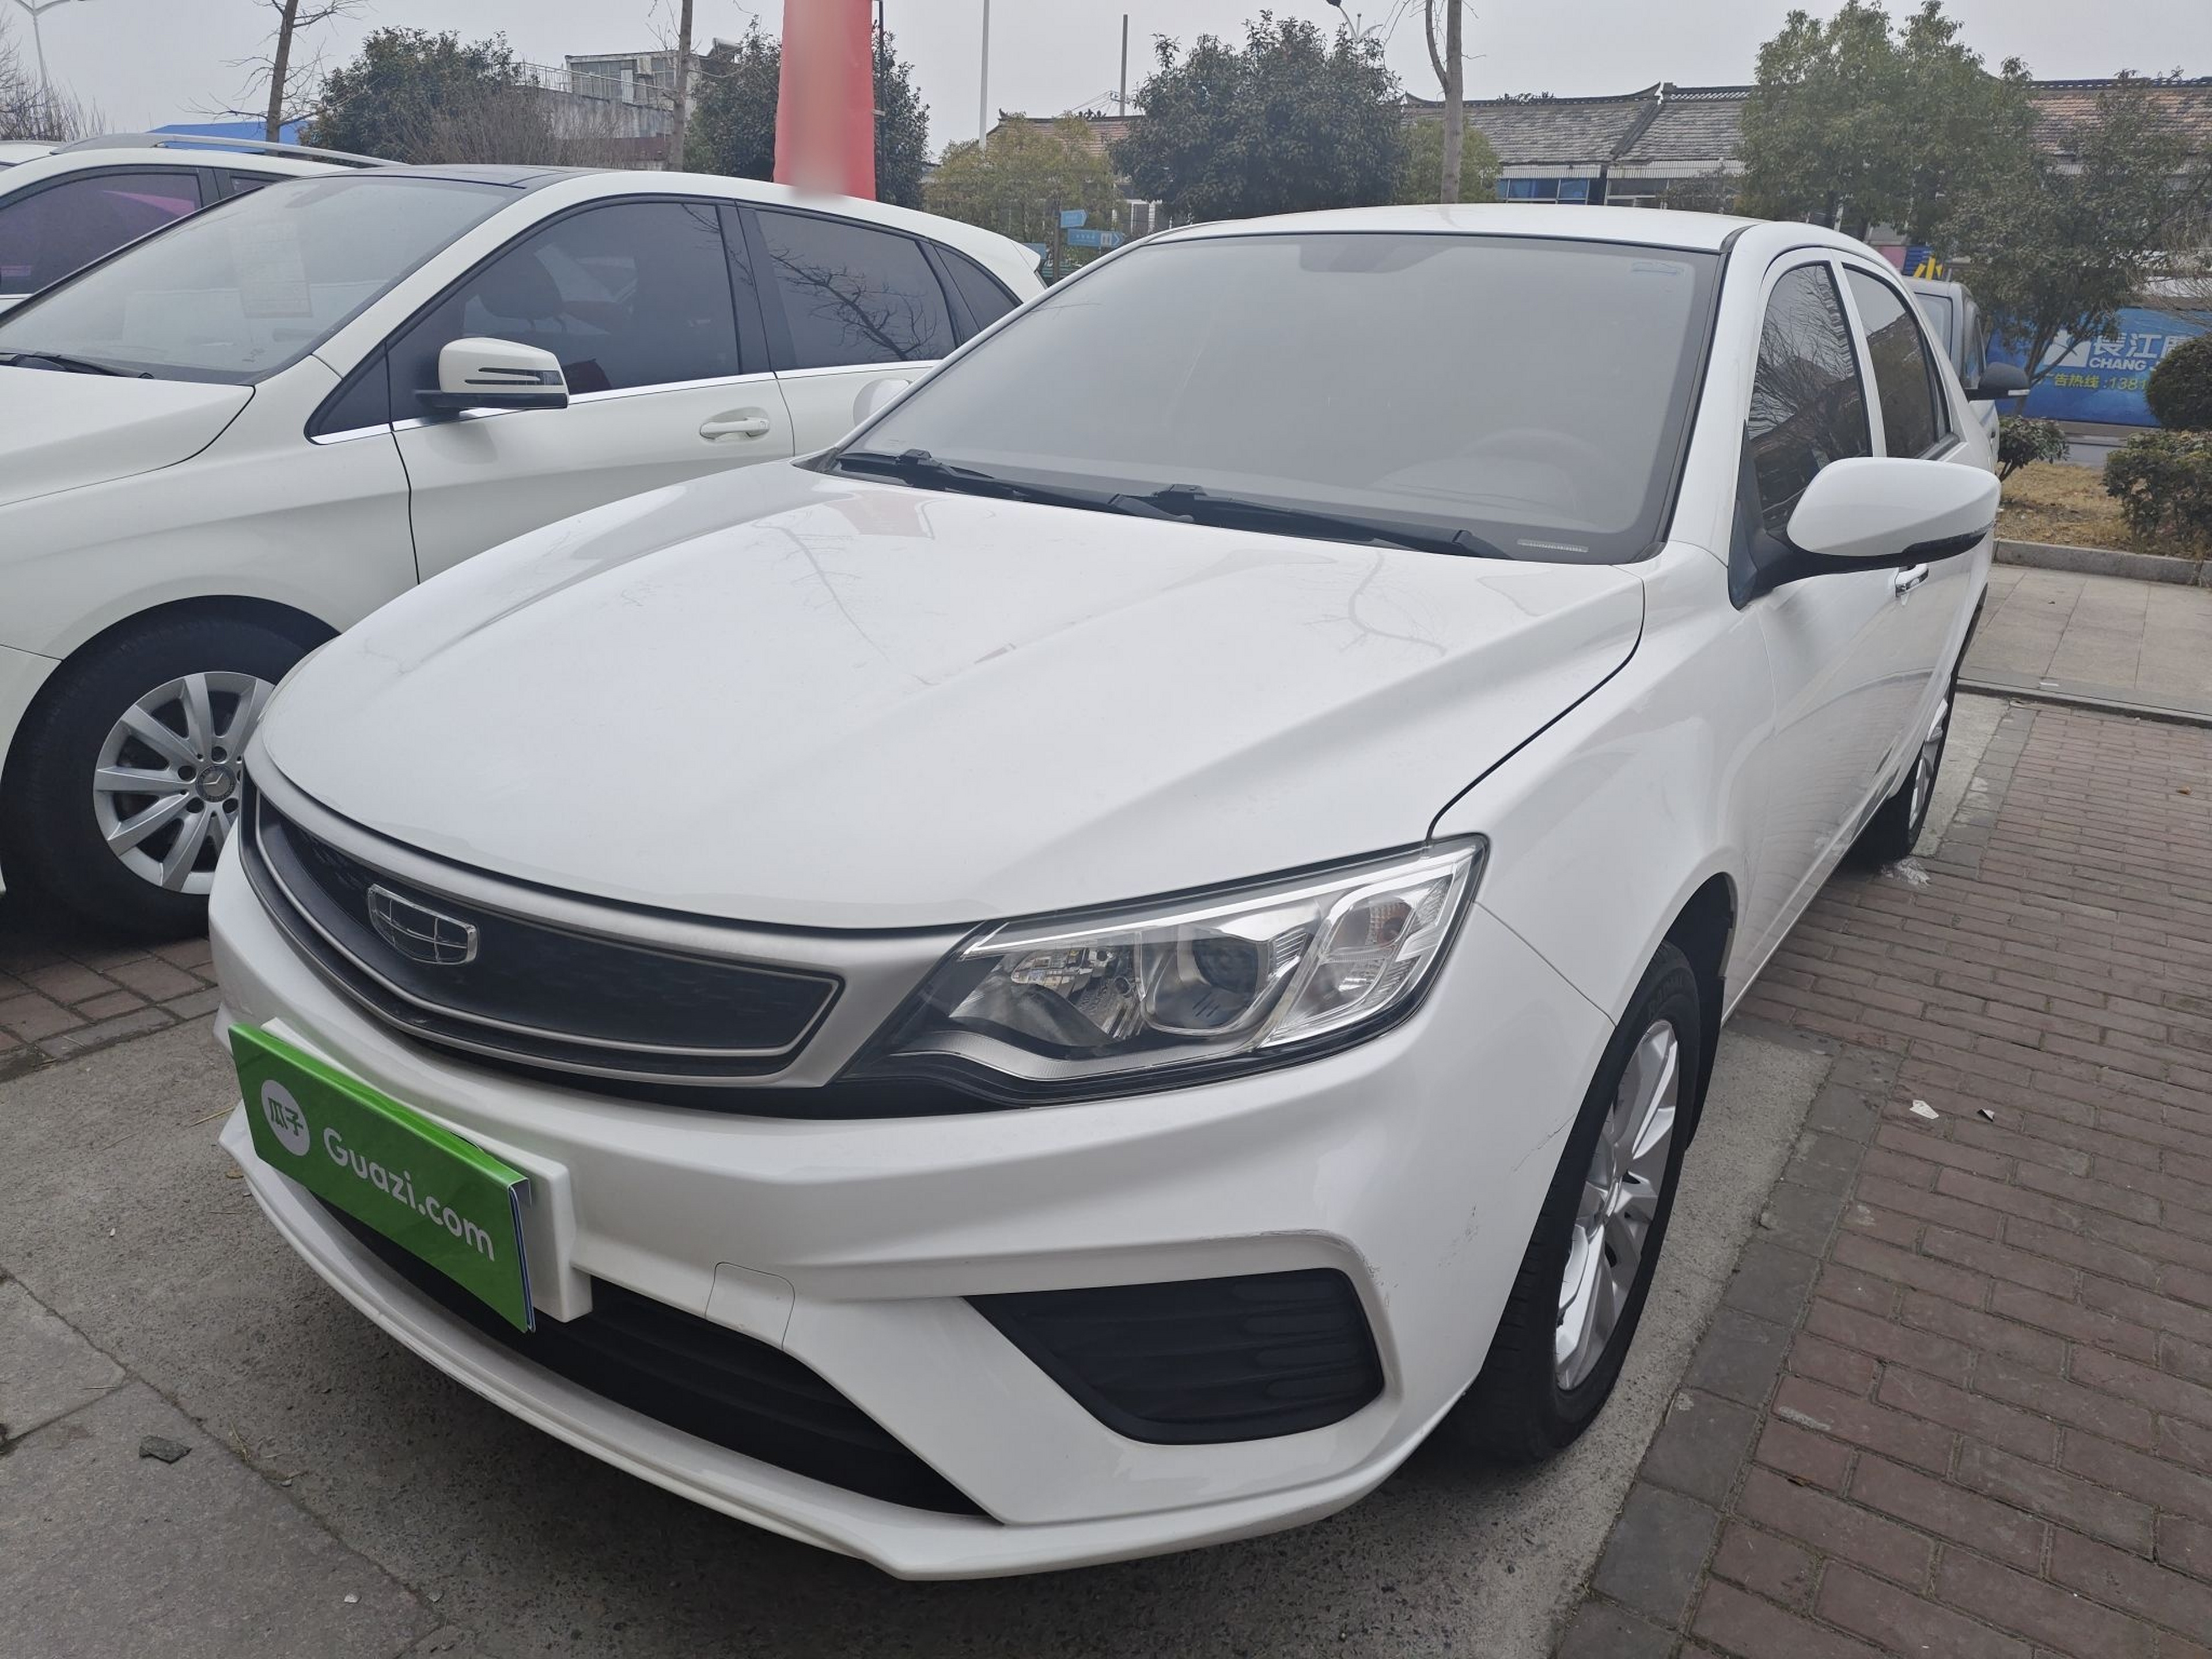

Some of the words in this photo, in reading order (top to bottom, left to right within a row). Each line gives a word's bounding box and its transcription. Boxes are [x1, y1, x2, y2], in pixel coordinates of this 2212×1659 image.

[2089, 357, 2147, 371] CHANG
[267, 1096, 304, 1137] 瓜子
[323, 1127, 495, 1262] Guazi.com
